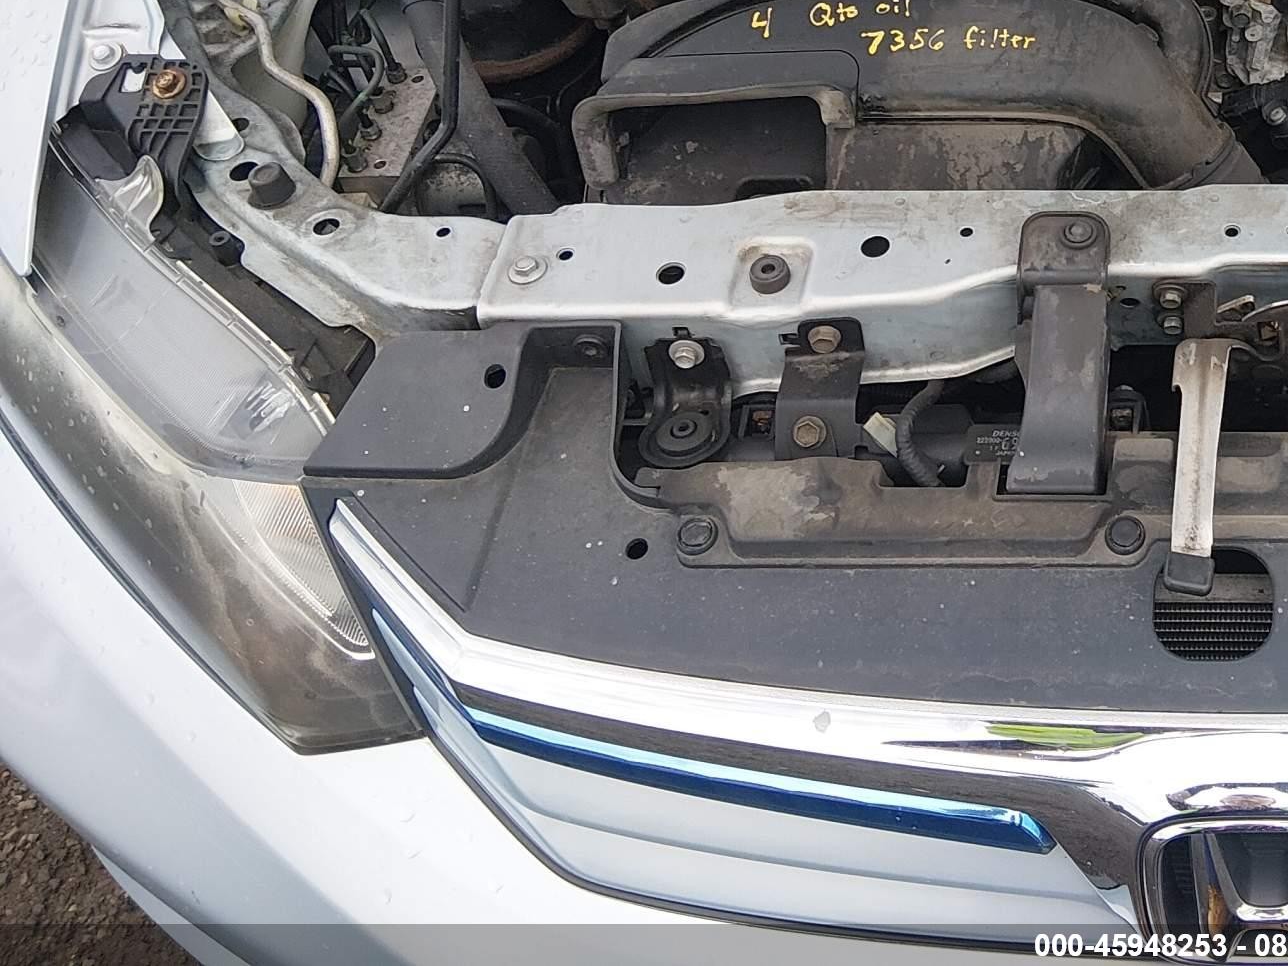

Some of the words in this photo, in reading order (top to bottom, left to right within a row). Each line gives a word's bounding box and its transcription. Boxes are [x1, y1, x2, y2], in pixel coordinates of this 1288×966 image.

[751, 7, 773, 39] 4
[860, 29, 946, 55] 7356
[962, 25, 1037, 51] filter
